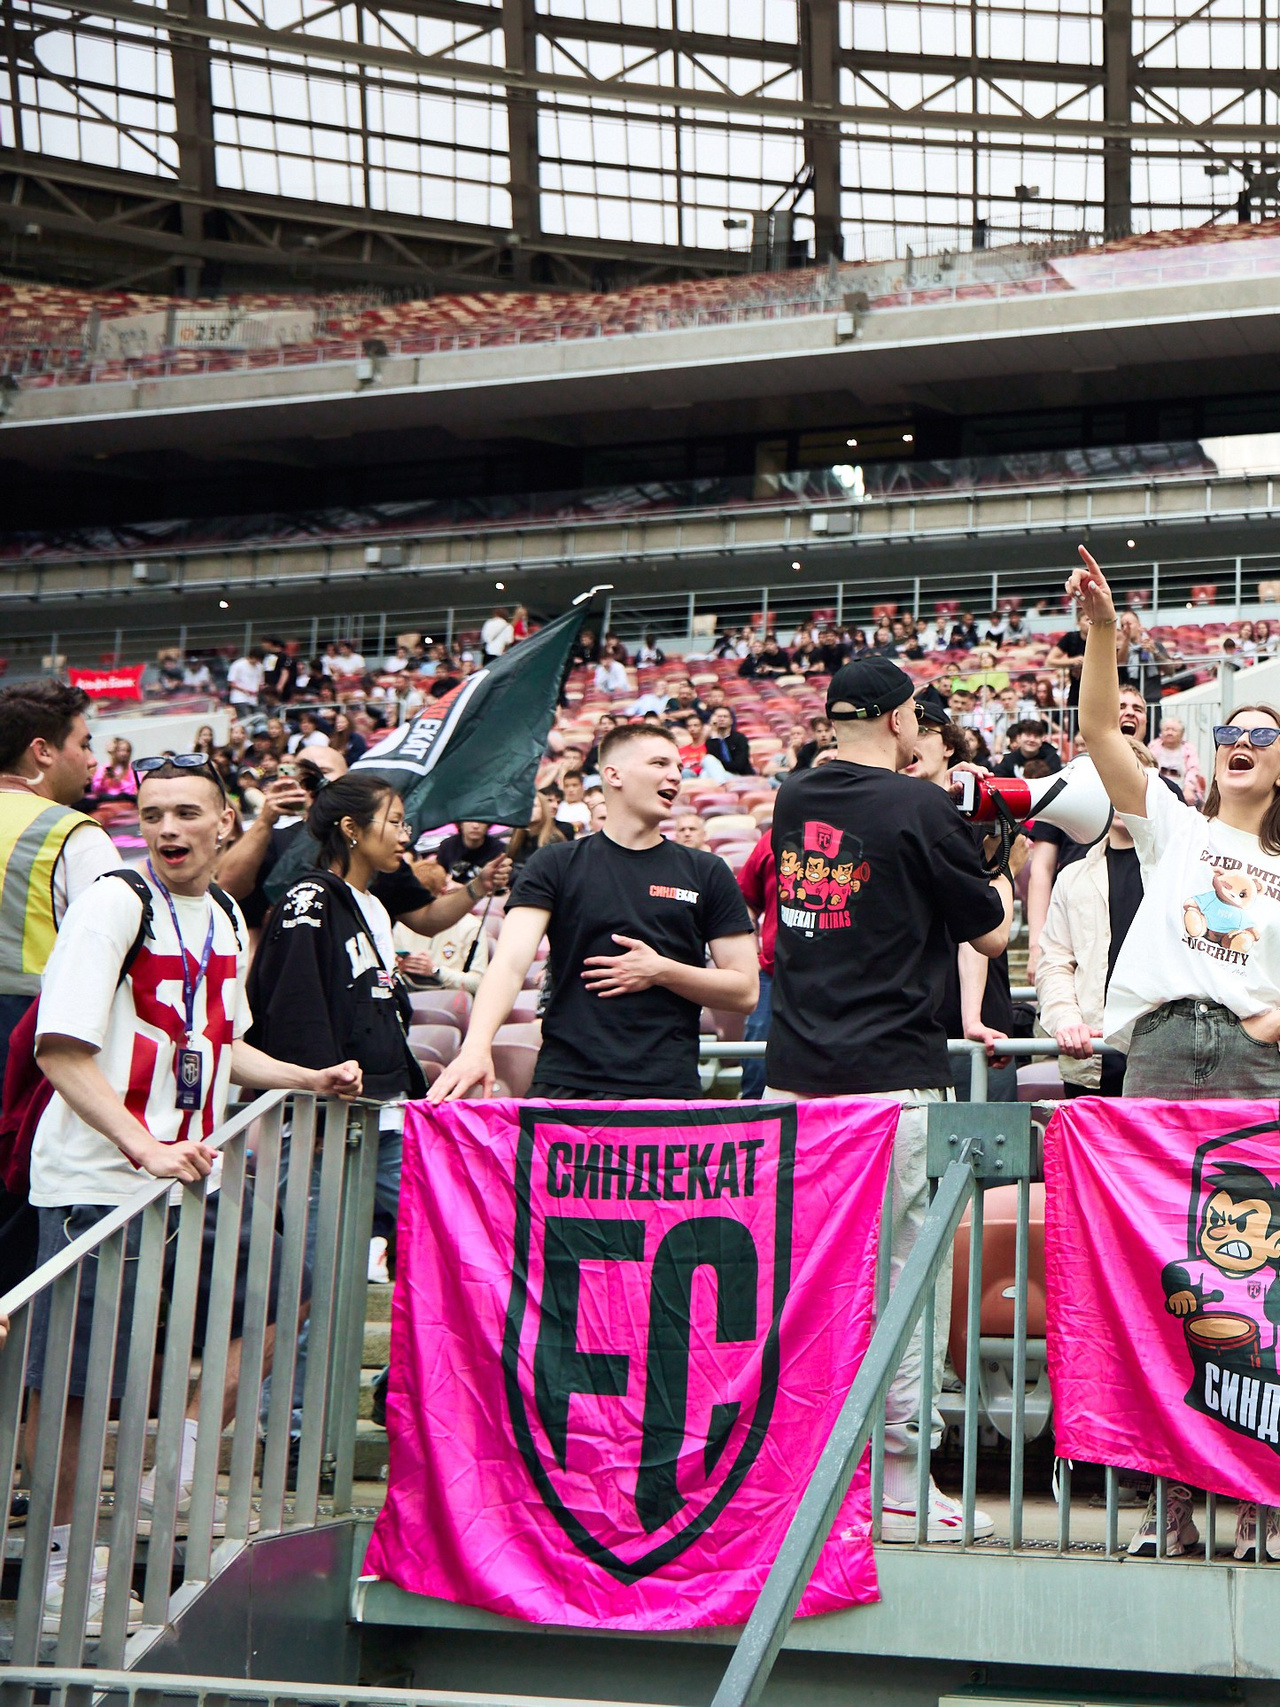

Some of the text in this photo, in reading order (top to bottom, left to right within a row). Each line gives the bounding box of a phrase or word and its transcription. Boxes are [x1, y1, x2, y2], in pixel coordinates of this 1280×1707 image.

[820, 833, 831, 848] FC
[649, 884, 699, 904] СИНДЕКАТ
[819, 910, 851, 929] ULTRAS
[547, 1139, 764, 1200] СИНДЕКАТ
[1249, 1284, 1260, 1297] FC
[533, 1216, 759, 1535] FC
